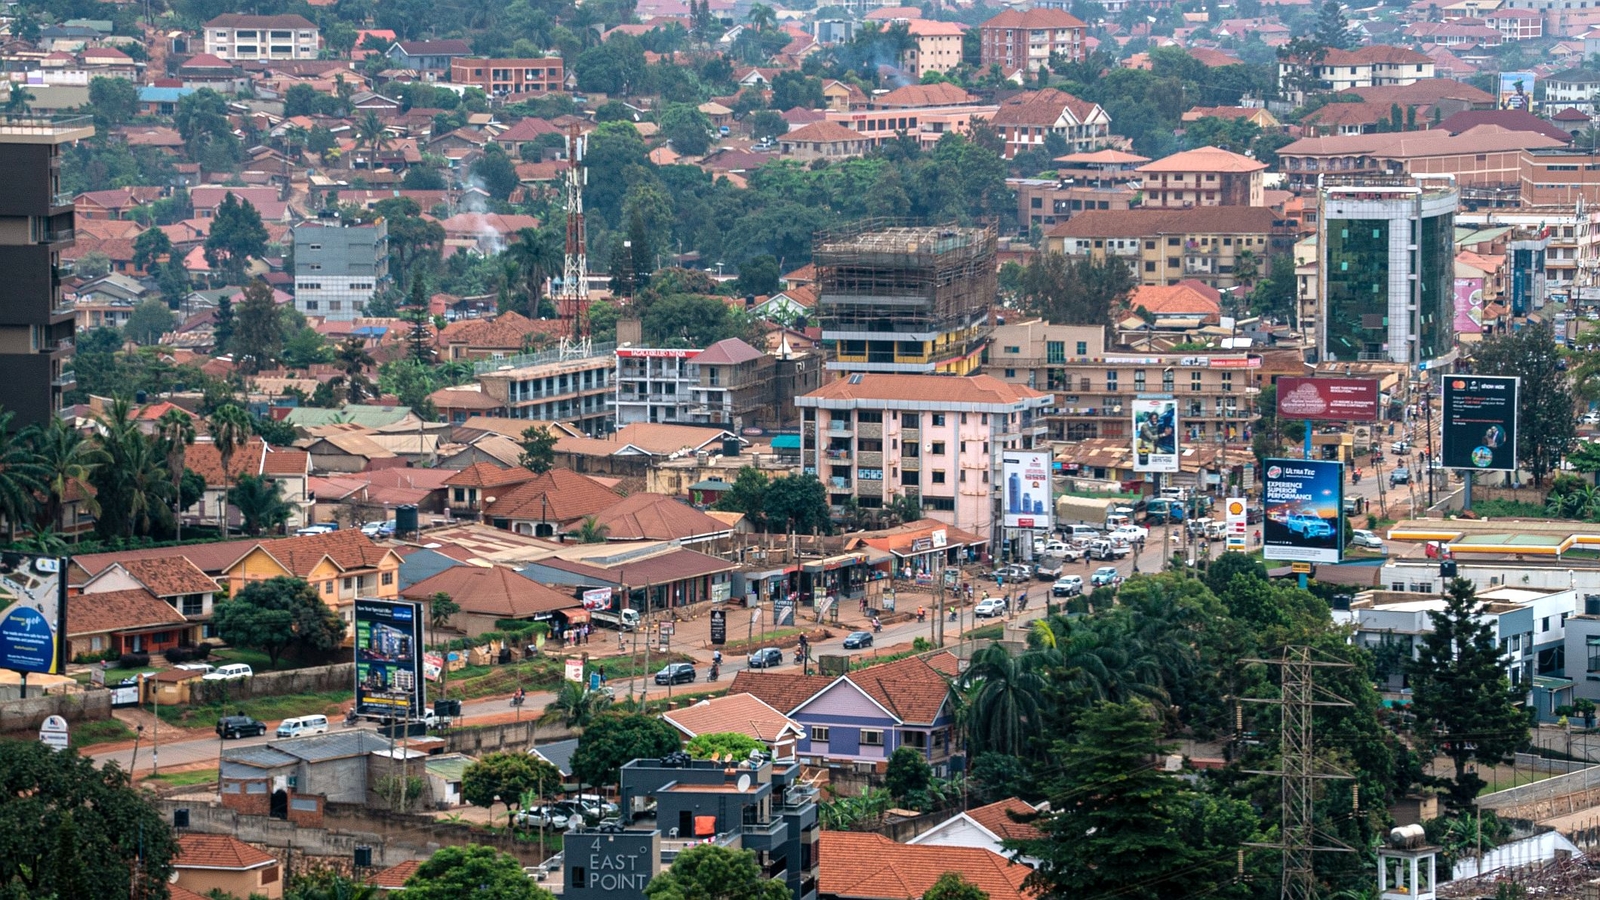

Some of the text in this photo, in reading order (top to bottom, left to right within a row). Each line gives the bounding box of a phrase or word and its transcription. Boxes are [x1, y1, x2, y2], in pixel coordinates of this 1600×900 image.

[1267, 481, 1303, 489] EXPERIENCE
[1267, 493, 1312, 501] PERFORMANCE
[591, 836, 601, 852] 4
[590, 853, 639, 870] EAST
[590, 872, 647, 890] POINT
